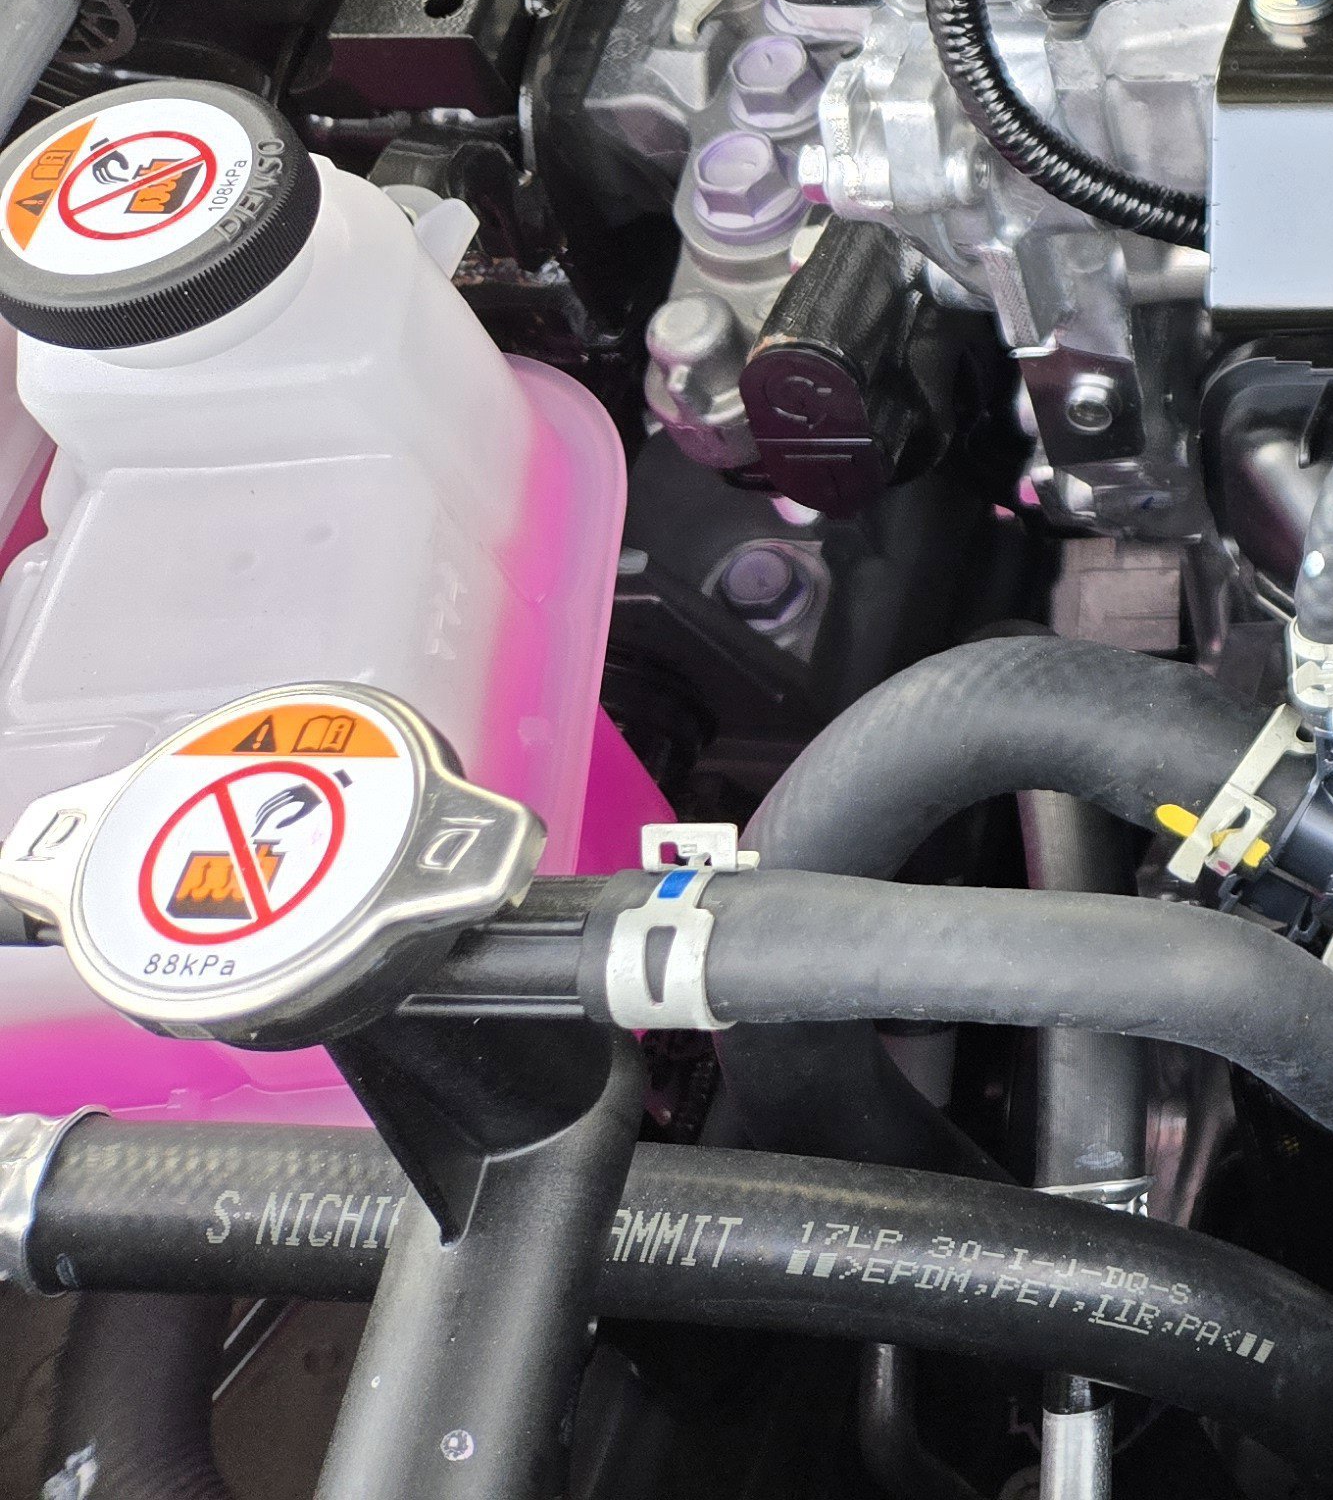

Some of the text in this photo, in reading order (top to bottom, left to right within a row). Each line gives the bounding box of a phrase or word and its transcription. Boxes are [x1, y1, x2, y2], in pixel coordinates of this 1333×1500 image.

[208, 160, 248, 212] 108kPa
[214, 140, 285, 242] DENSO
[143, 953, 238, 977] 88kPa
[802, 1221, 904, 1251] 17LP
